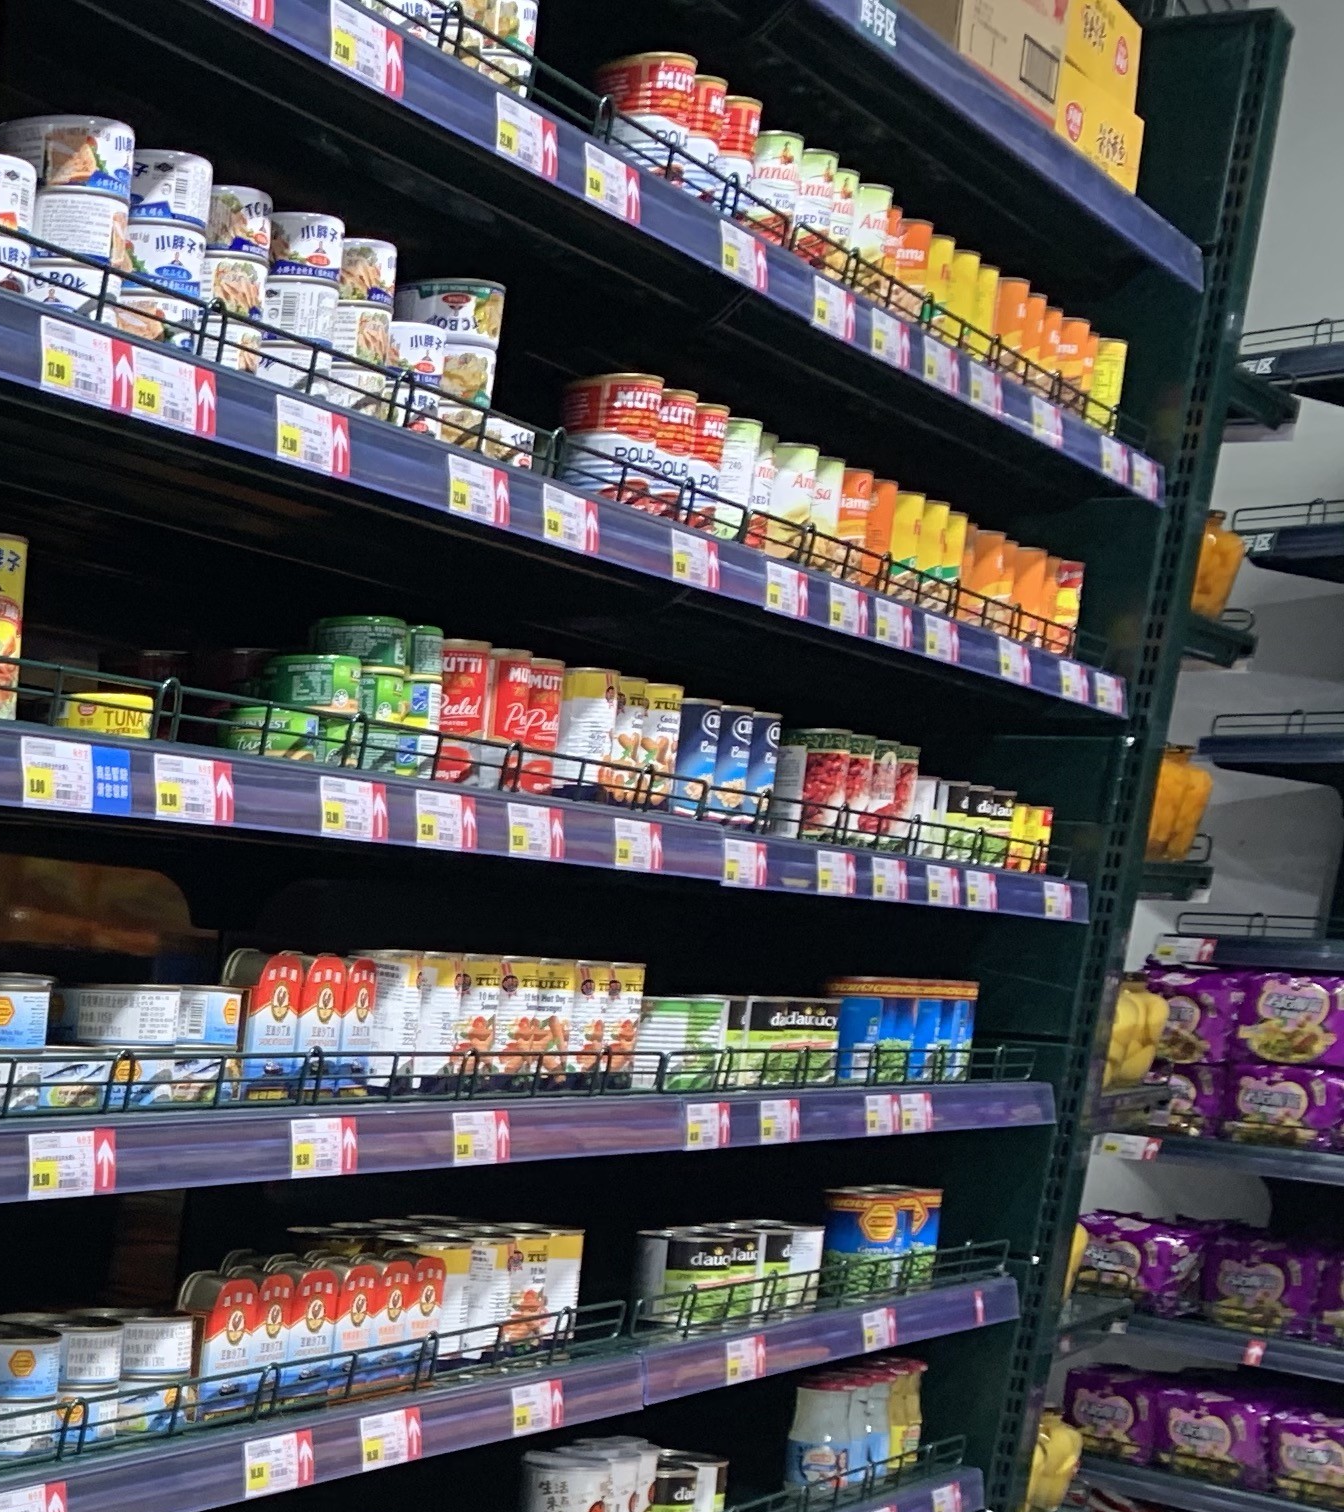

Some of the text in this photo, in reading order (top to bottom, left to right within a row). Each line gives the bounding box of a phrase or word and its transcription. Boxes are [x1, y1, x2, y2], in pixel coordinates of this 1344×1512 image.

[156, 234, 198, 254] 小胖子
[103, 707, 144, 730] TUNA
